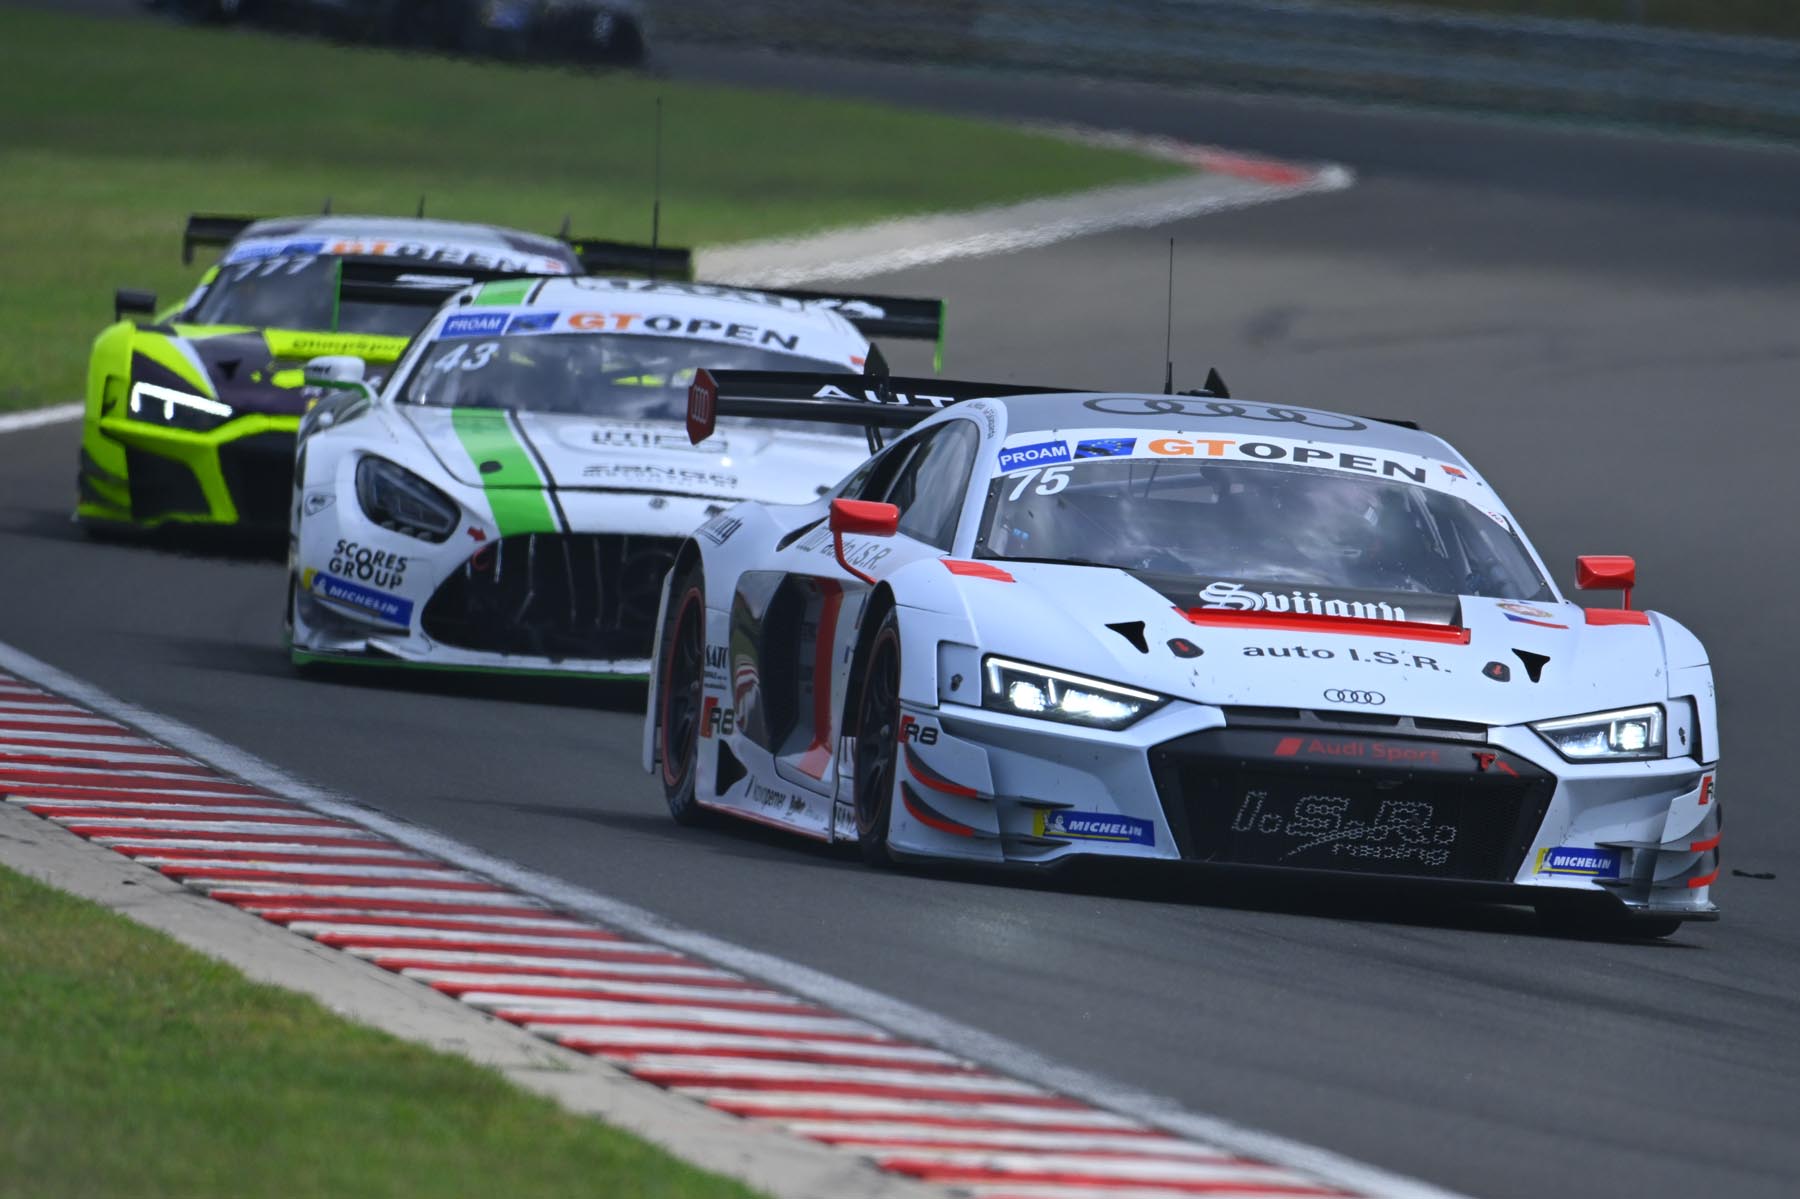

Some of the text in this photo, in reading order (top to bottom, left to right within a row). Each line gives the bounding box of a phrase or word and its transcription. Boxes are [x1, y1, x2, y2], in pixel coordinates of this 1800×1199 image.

[449, 318, 502, 330] PROAM
[434, 343, 499, 372] 43
[1000, 446, 1067, 466] PROAM
[1007, 466, 1075, 501] 75
[333, 538, 408, 573] SCORES
[328, 557, 403, 590] GROUP
[329, 586, 399, 614] MICHELIN
[1243, 646, 1453, 674] auto I.S.R.
[709, 706, 735, 735] R8
[904, 722, 939, 746] R8
[1306, 739, 1441, 763] Audi Sport
[1068, 820, 1143, 837] MICHELIN
[1553, 854, 1611, 870] MICHELIN
